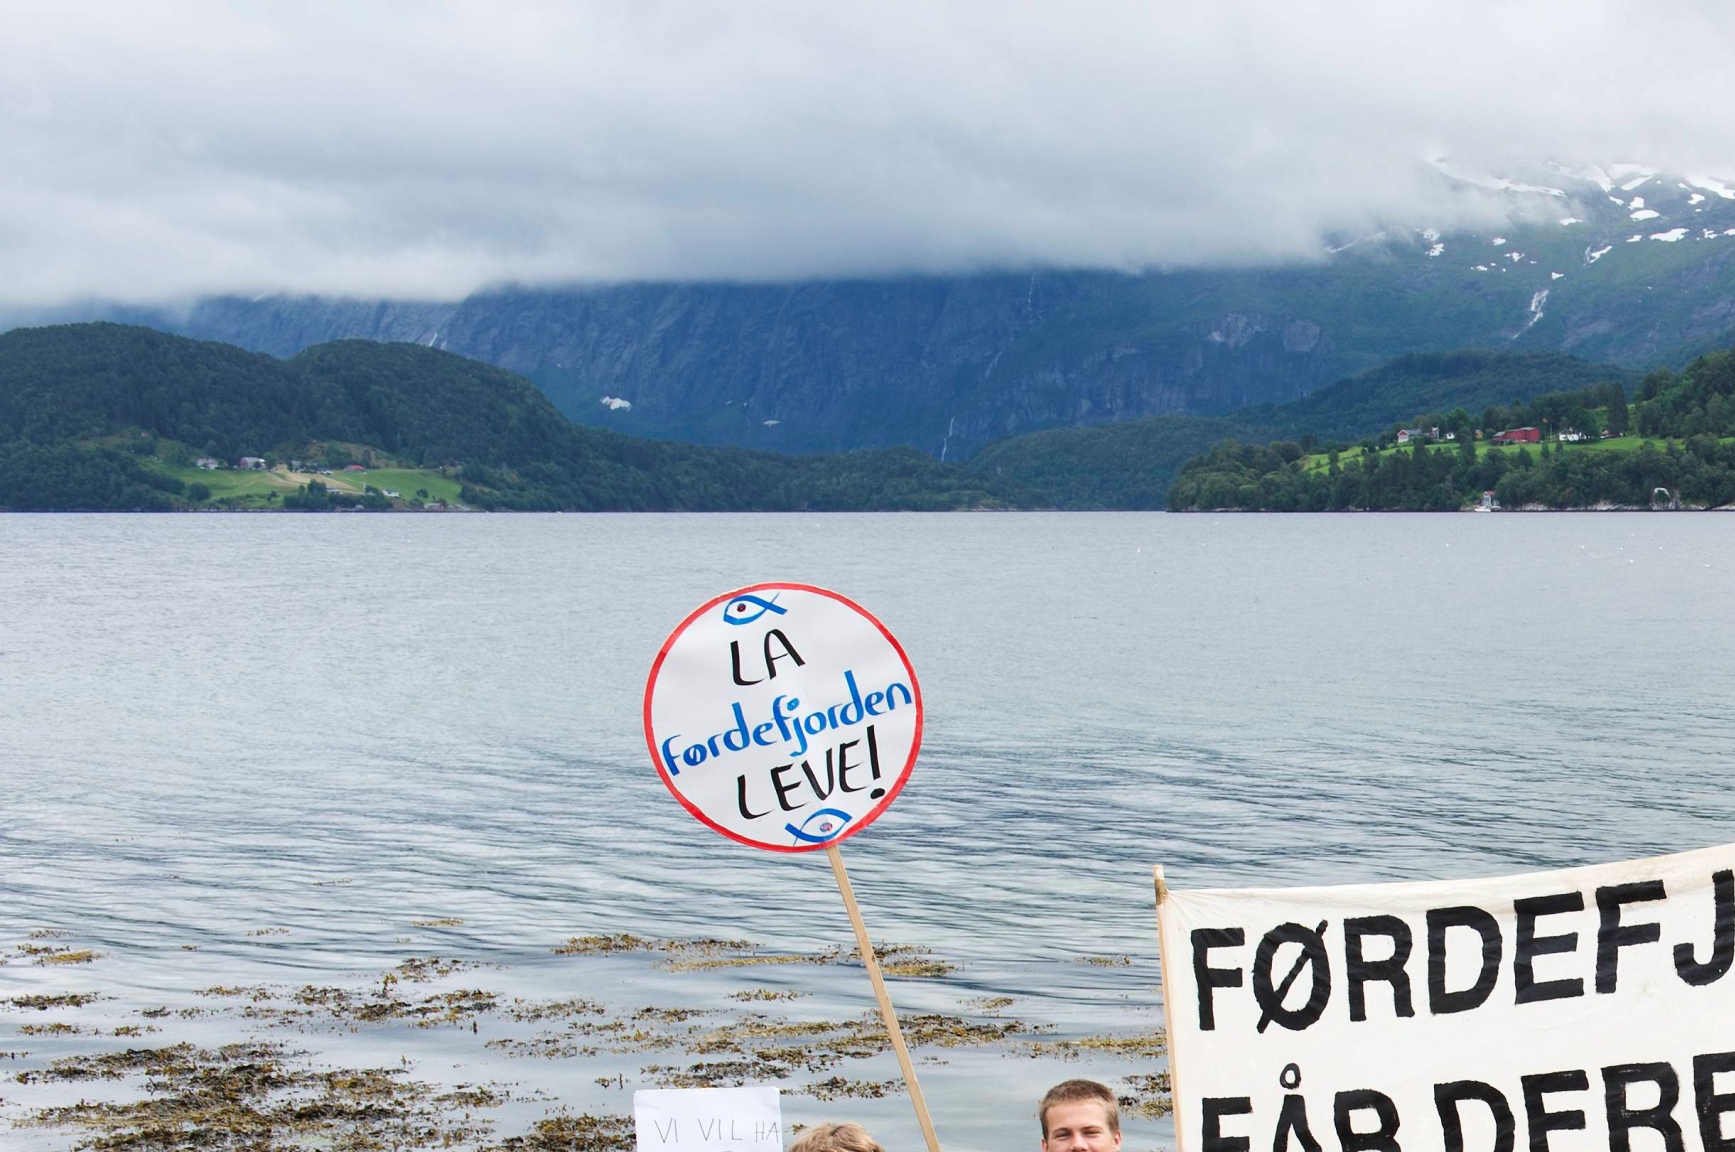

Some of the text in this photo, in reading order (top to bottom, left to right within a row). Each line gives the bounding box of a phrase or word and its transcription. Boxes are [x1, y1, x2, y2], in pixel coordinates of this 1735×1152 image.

[730, 629, 806, 686] LA
[737, 724, 886, 820] LEVE!
[654, 1118, 780, 1143] VI VIL HA
